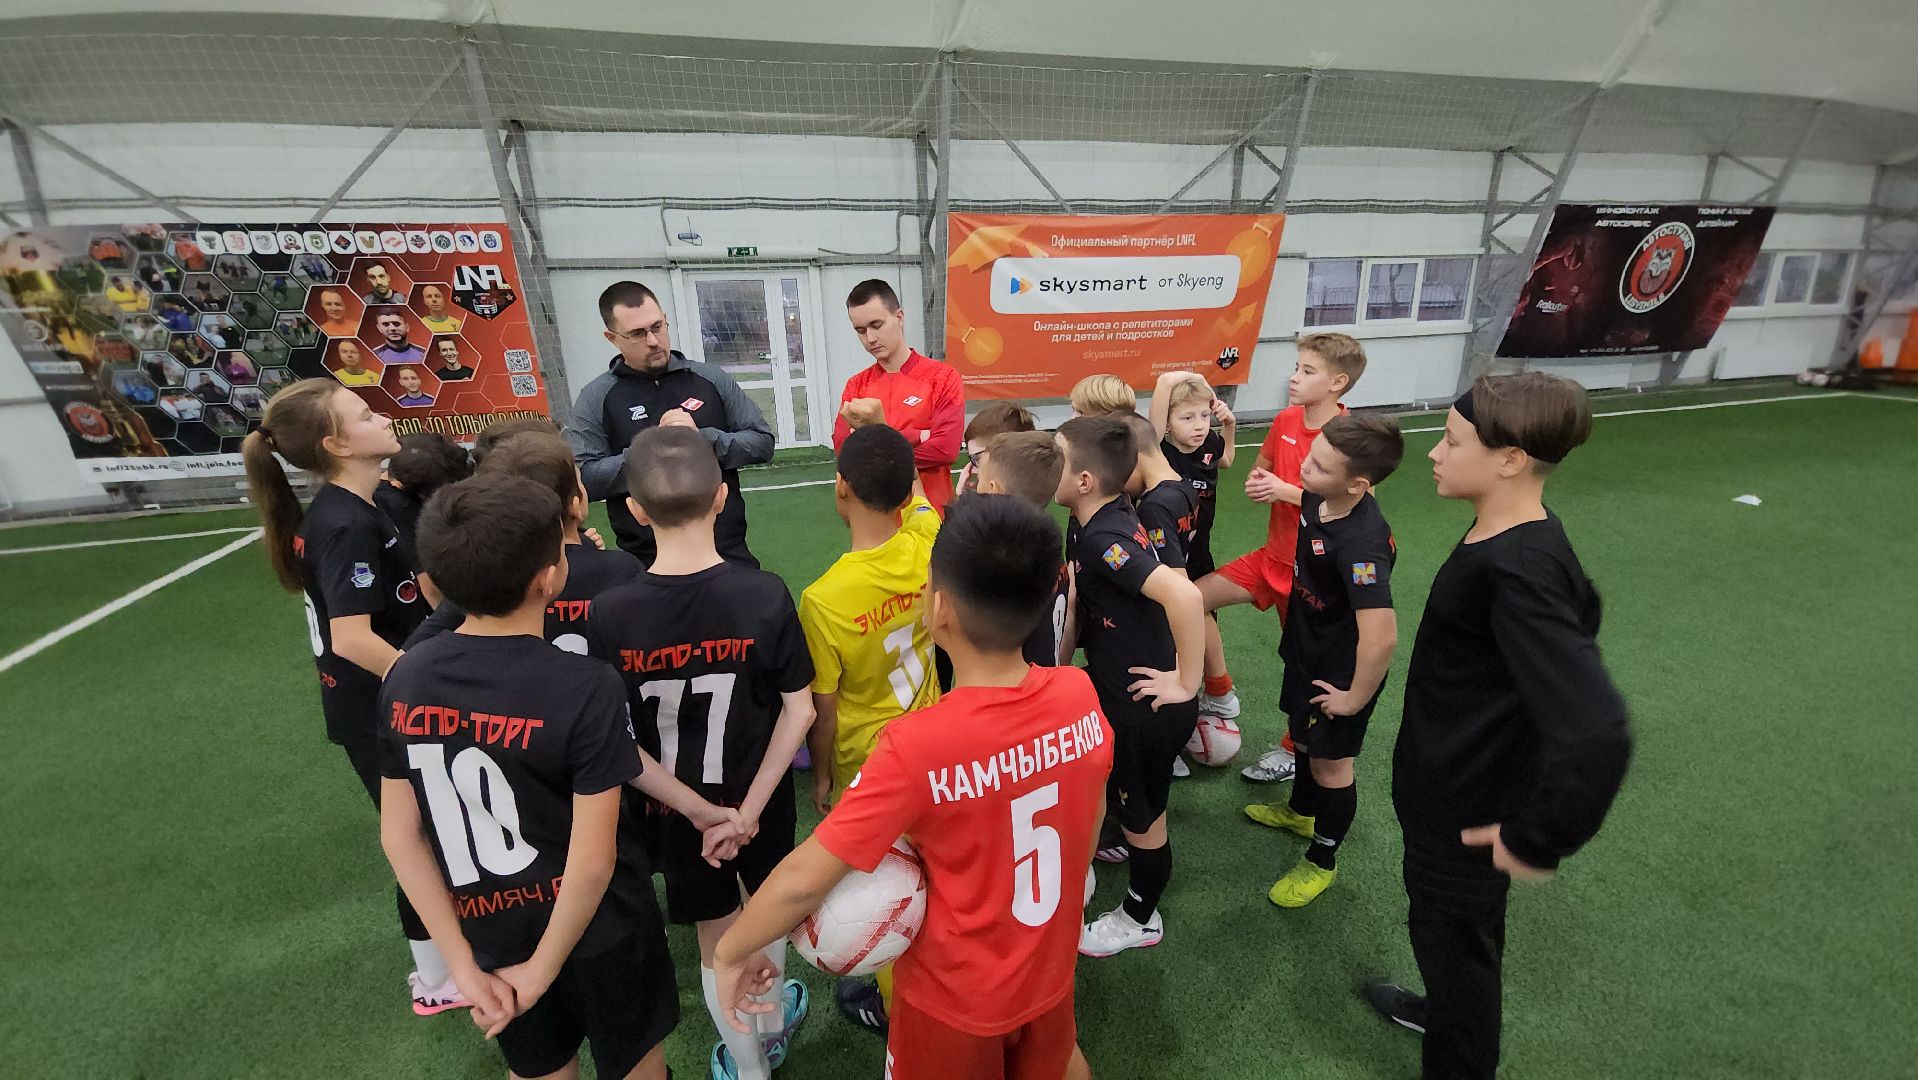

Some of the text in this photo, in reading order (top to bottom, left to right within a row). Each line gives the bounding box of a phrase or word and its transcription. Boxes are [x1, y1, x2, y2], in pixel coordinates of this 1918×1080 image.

[1051, 234, 1129, 250] Официальный
[1130, 234, 1175, 250] партнёр
[1039, 273, 1224, 294] skysmart от Skyeng
[1033, 318, 1194, 332] Онлайн-школа с репетиторами
[1051, 328, 1174, 343] для детей и подростков
[1082, 348, 1141, 362] skysmart.ru
[619, 638, 755, 673] ЭКСПО-ТОРГ
[390, 700, 544, 750] ЭКСПО-ТОРГ
[927, 710, 1104, 805] КАМЧЫБЕКОВ
[406, 743, 540, 887] 10
[1010, 781, 1062, 927] 5
